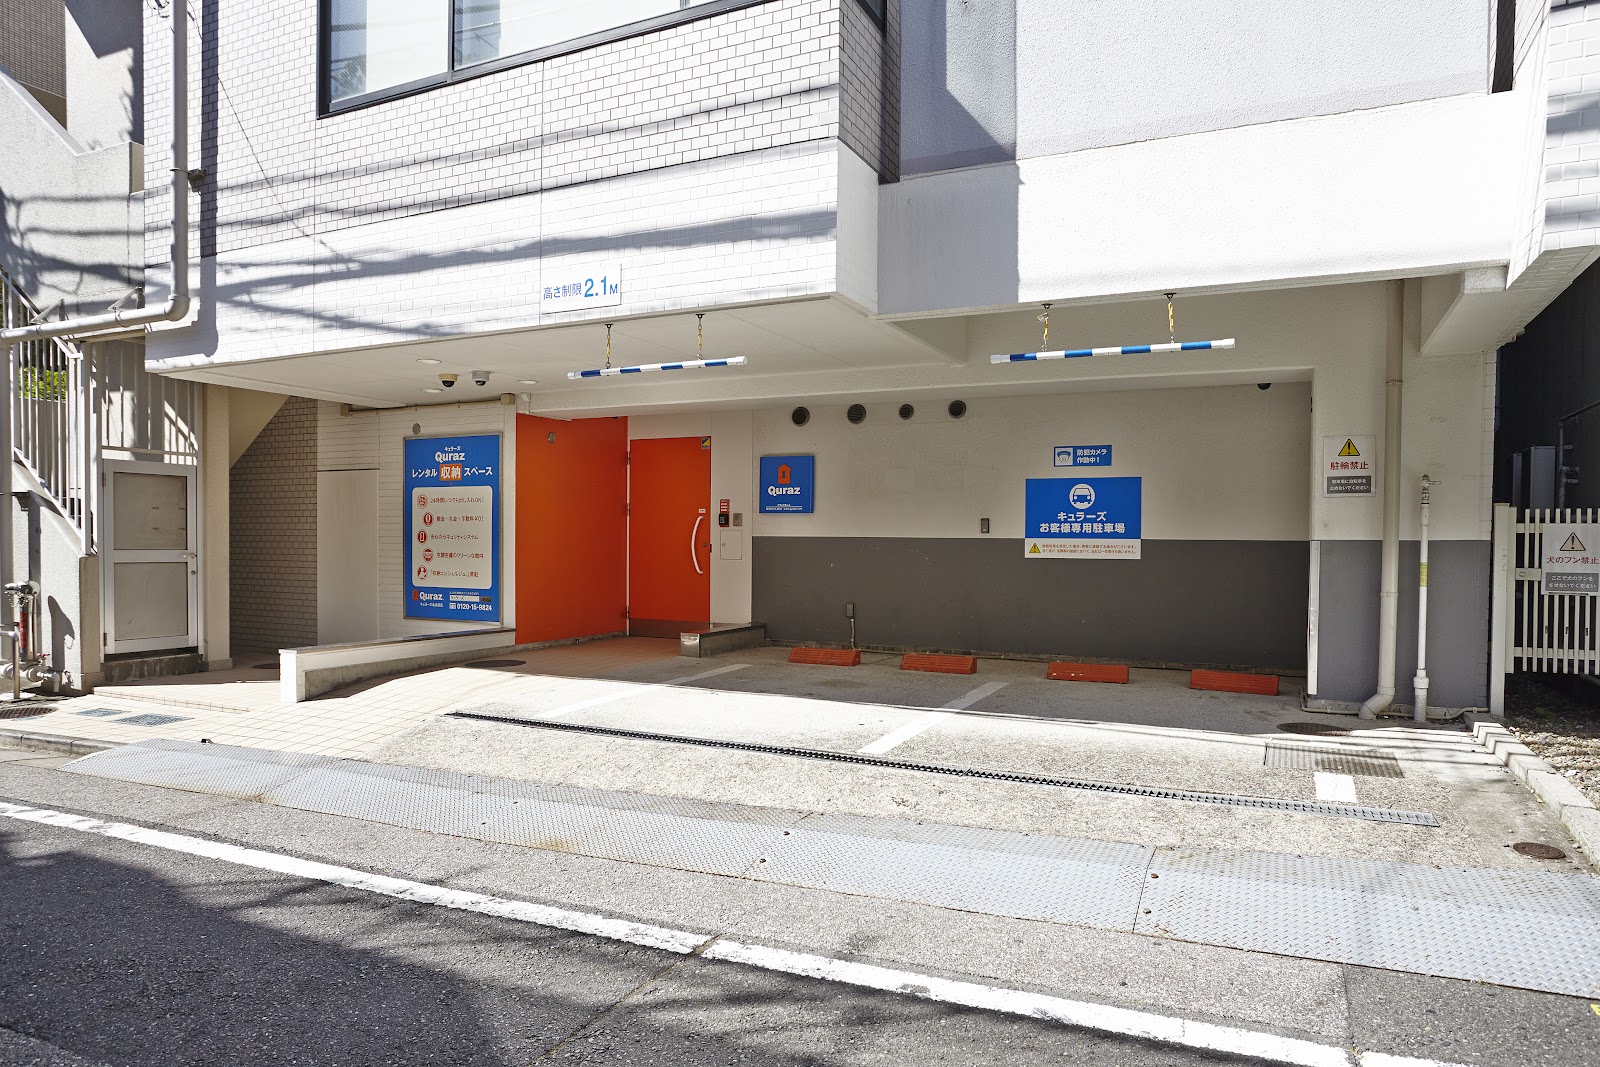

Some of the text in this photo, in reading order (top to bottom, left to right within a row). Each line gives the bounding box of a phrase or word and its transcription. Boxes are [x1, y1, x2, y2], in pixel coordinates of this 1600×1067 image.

[543, 276, 618, 300] 高さ制限 2.1M
[435, 452, 465, 463] Quraz
[1331, 461, 1369, 470] 駐輪禁止
[412, 466, 493, 479] レンタル 収納 スペース
[768, 486, 801, 496] Quraz
[1057, 511, 1107, 521] キュラーズ
[1040, 523, 1125, 533] お客様専用駐車場
[1546, 556, 1599, 565] 犬のフン禁止
[420, 592, 443, 601] Quraz
